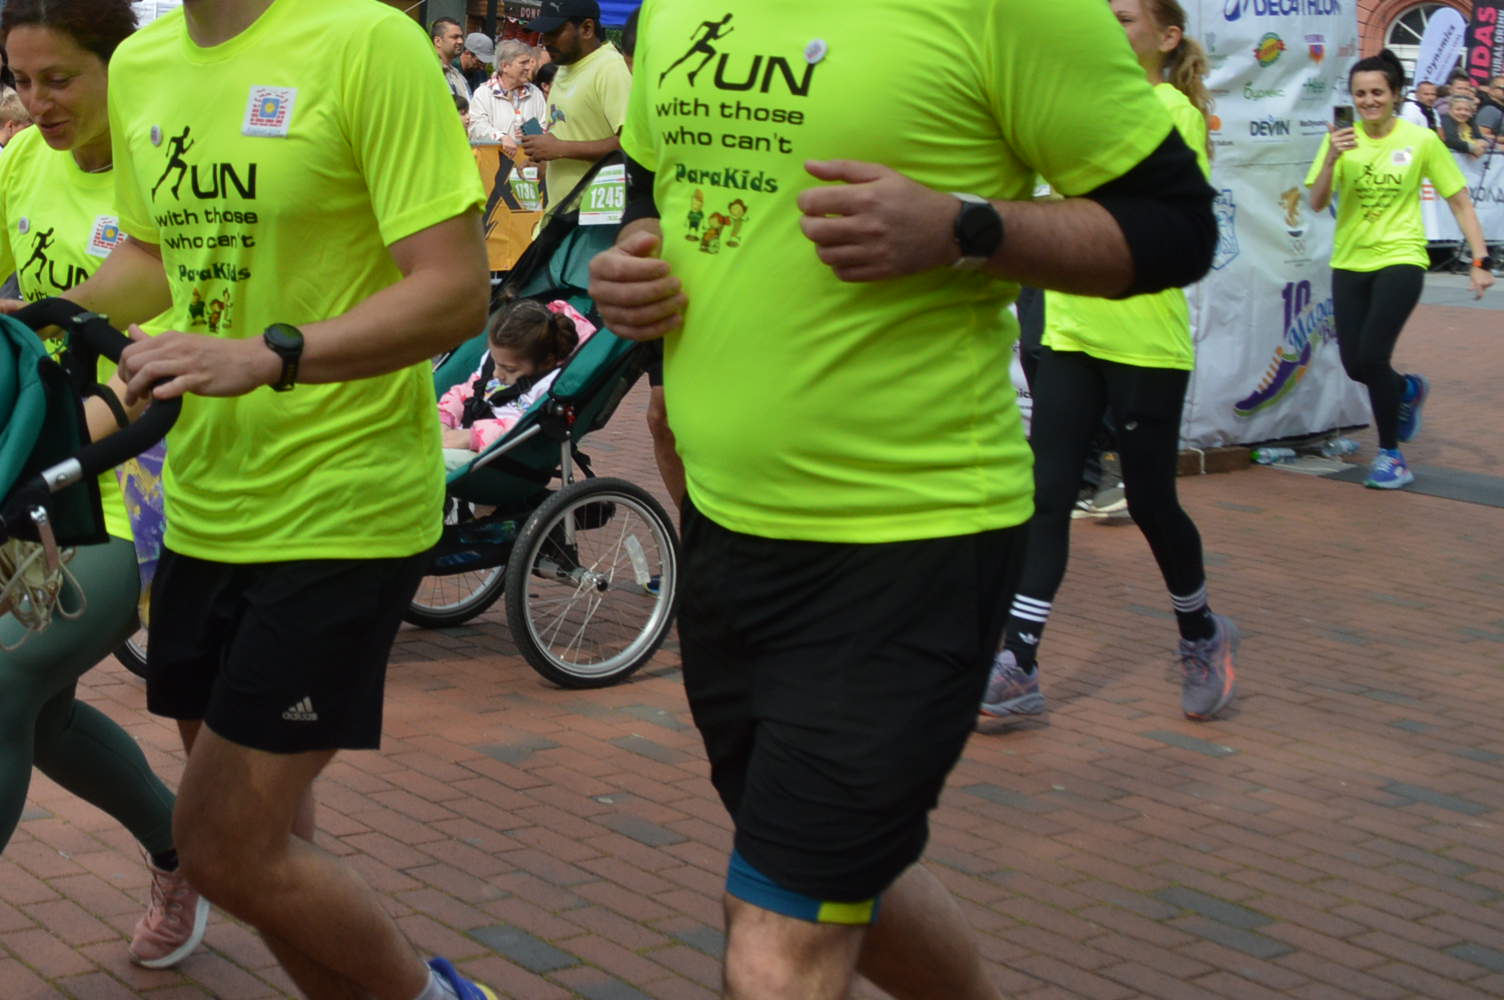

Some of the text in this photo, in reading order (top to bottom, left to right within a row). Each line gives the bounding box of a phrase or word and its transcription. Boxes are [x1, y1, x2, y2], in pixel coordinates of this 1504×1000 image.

[656, 97, 805, 125] with those
[1250, 115, 1291, 136] DEVIN
[662, 125, 794, 155] who can't
[674, 162, 780, 194] ParaKids
[591, 185, 625, 210] 1245
[155, 207, 259, 227] with those
[164, 232, 256, 250] who can't
[178, 262, 252, 283] ParaKids
